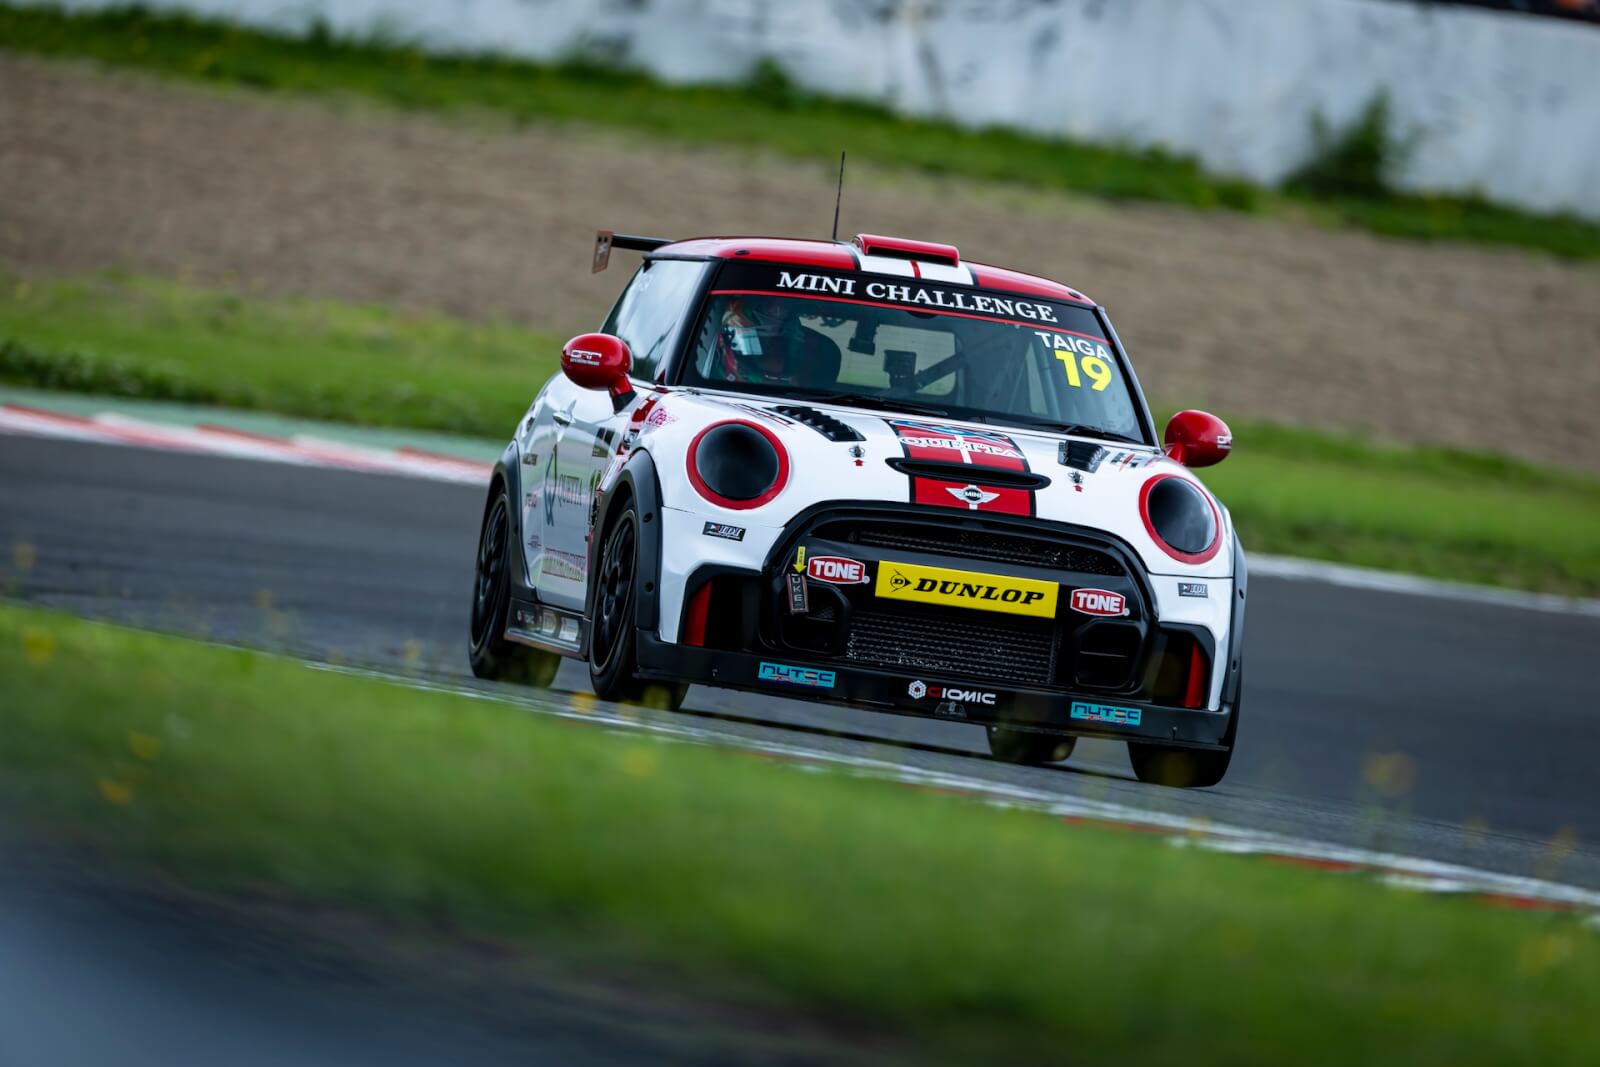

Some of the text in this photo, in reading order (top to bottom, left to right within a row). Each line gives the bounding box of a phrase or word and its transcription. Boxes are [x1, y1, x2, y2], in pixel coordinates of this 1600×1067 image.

[777, 272, 1059, 323] MINI CHALLENGE
[1035, 331, 1113, 363] TAIGA
[1055, 350, 1112, 392] 19
[965, 490, 983, 500] MINI
[813, 560, 861, 580] TONE
[791, 573, 804, 602] UKE
[913, 577, 1045, 605] DUNLOP
[1076, 592, 1122, 612] TONE
[927, 685, 997, 705] CIOMIC
